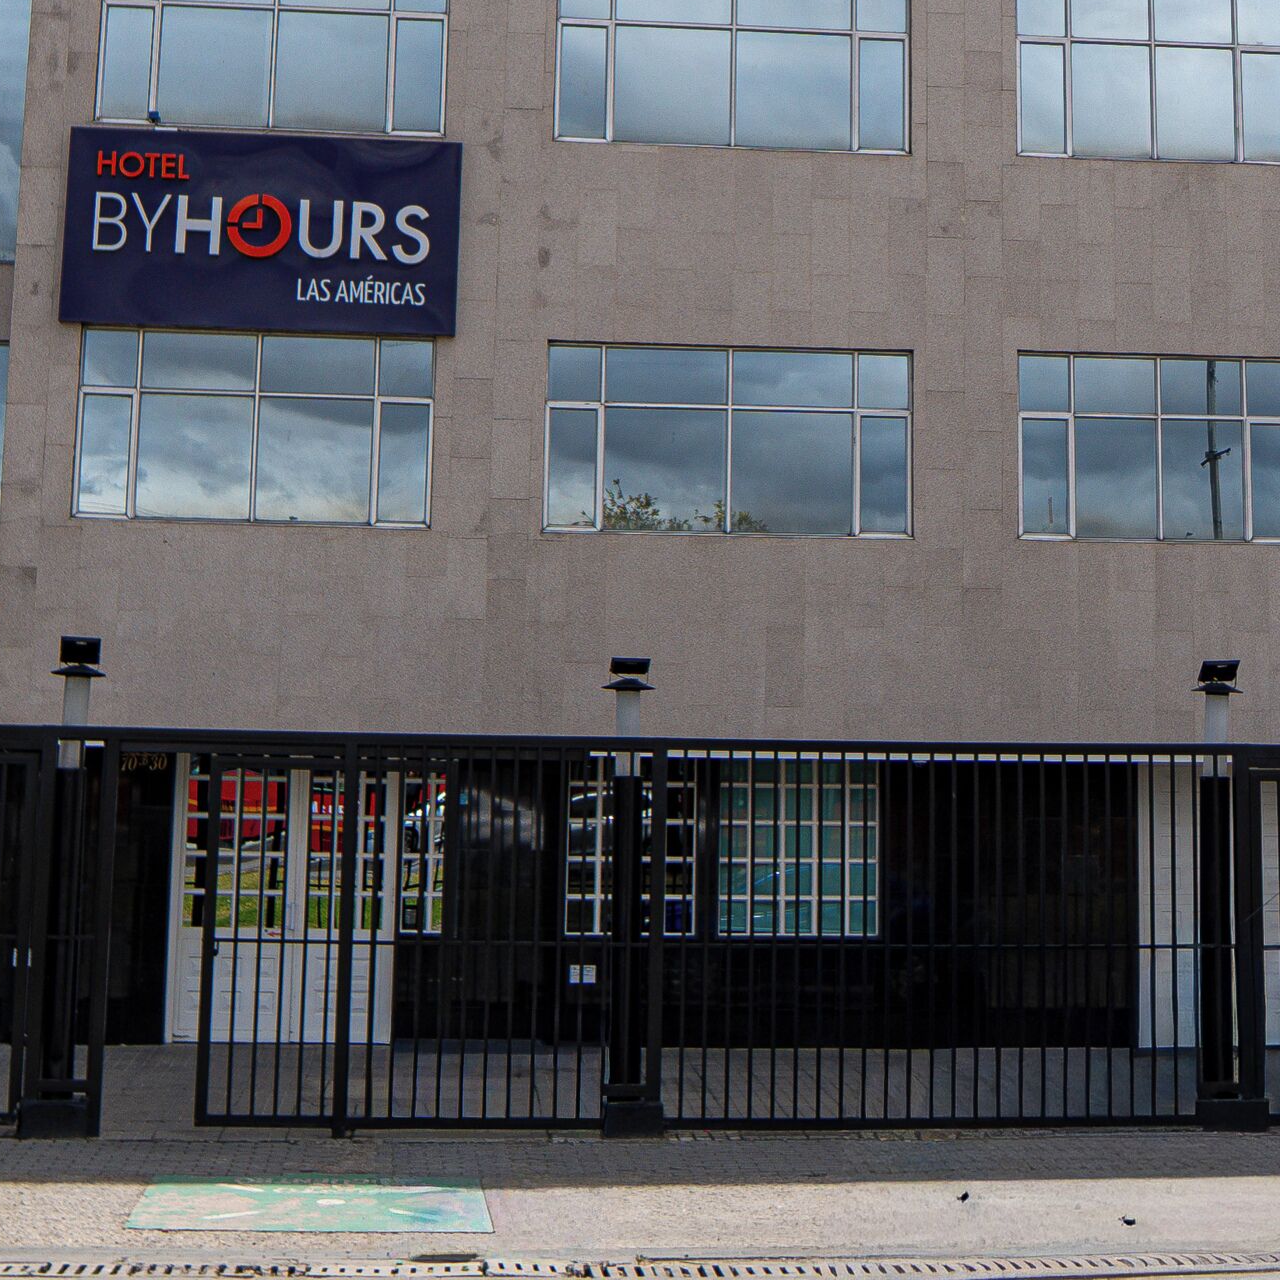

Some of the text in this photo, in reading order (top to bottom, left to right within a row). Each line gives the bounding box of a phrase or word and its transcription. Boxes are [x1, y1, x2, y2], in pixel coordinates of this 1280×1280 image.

[96, 150, 190, 180] HOTEL
[92, 191, 430, 265] BYHOURS
[296, 275, 426, 306] LAS AMÉRICAS
